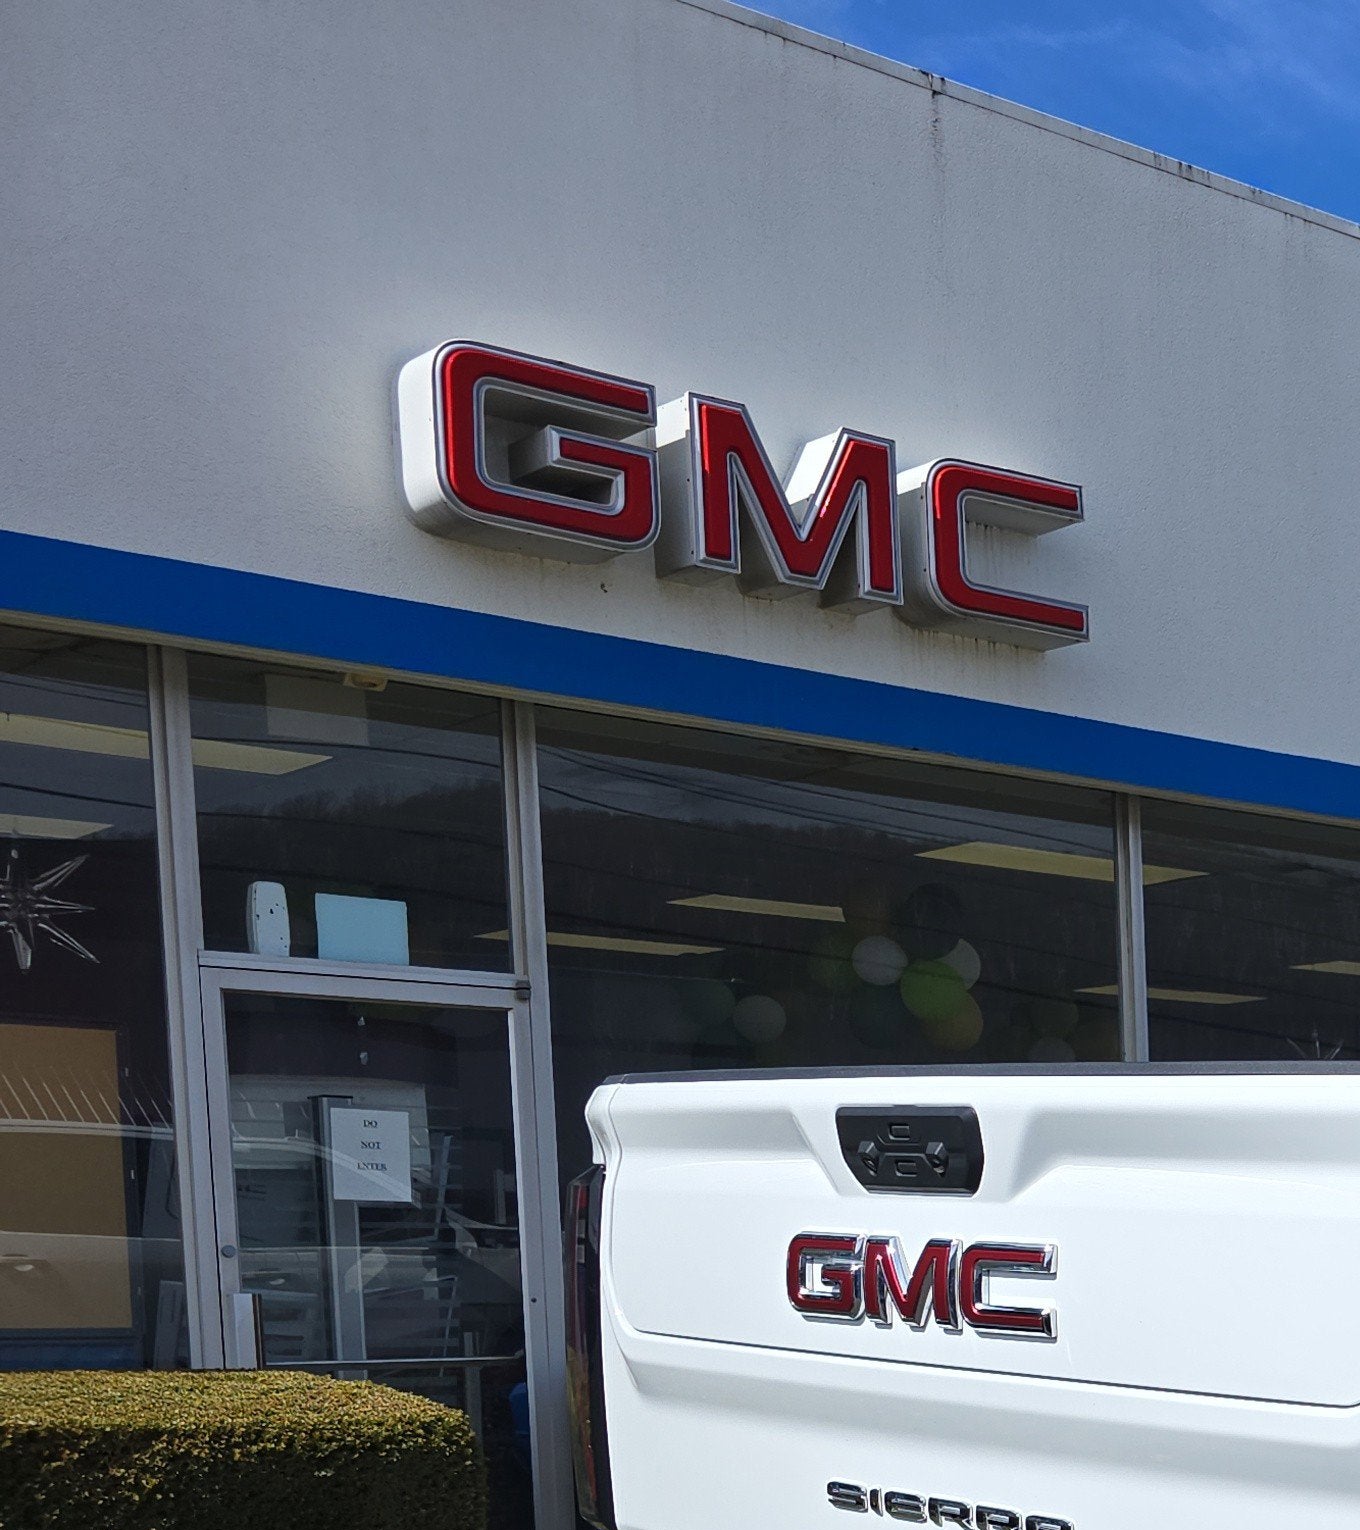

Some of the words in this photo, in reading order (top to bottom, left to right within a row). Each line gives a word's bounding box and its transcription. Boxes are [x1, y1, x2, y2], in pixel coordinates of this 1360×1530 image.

[402, 338, 1091, 646] GMC
[363, 1119, 378, 1129] DO
[360, 1140, 382, 1150] NOT
[357, 1162, 388, 1172] ENTER
[786, 1230, 1058, 1343] GMC
